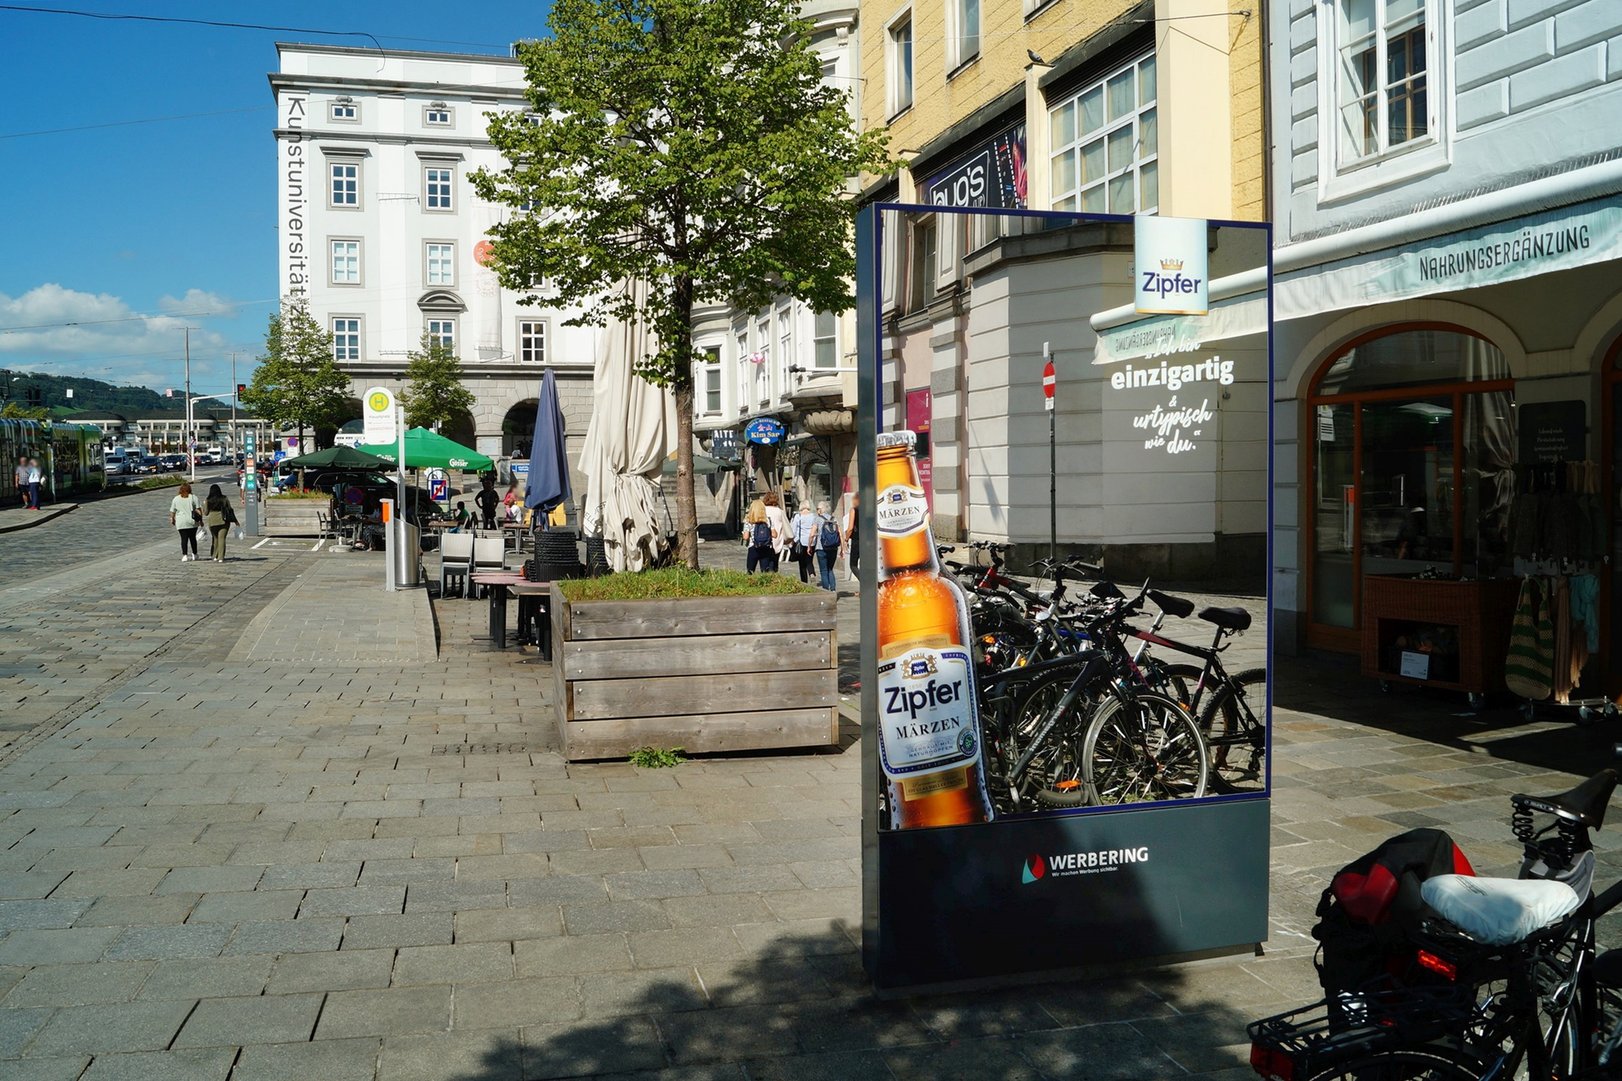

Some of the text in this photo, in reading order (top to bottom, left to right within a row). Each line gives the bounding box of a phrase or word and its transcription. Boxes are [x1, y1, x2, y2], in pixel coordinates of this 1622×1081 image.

[288, 97, 309, 296] Kunstuniversität
[1420, 225, 1590, 281] NAHRUNGSERGÄNZUNG
[1142, 272, 1201, 299] Zipfer
[1111, 356, 1234, 390] einzigartig
[1168, 395, 1177, 407] &
[1133, 398, 1212, 436] urtypisch
[1145, 435, 1165, 450] wie
[879, 506, 921, 520] MÄRZEN
[884, 679, 962, 720] Zipfer
[896, 716, 961, 740] MÄRZEN
[1049, 847, 1149, 870] WERBERING
